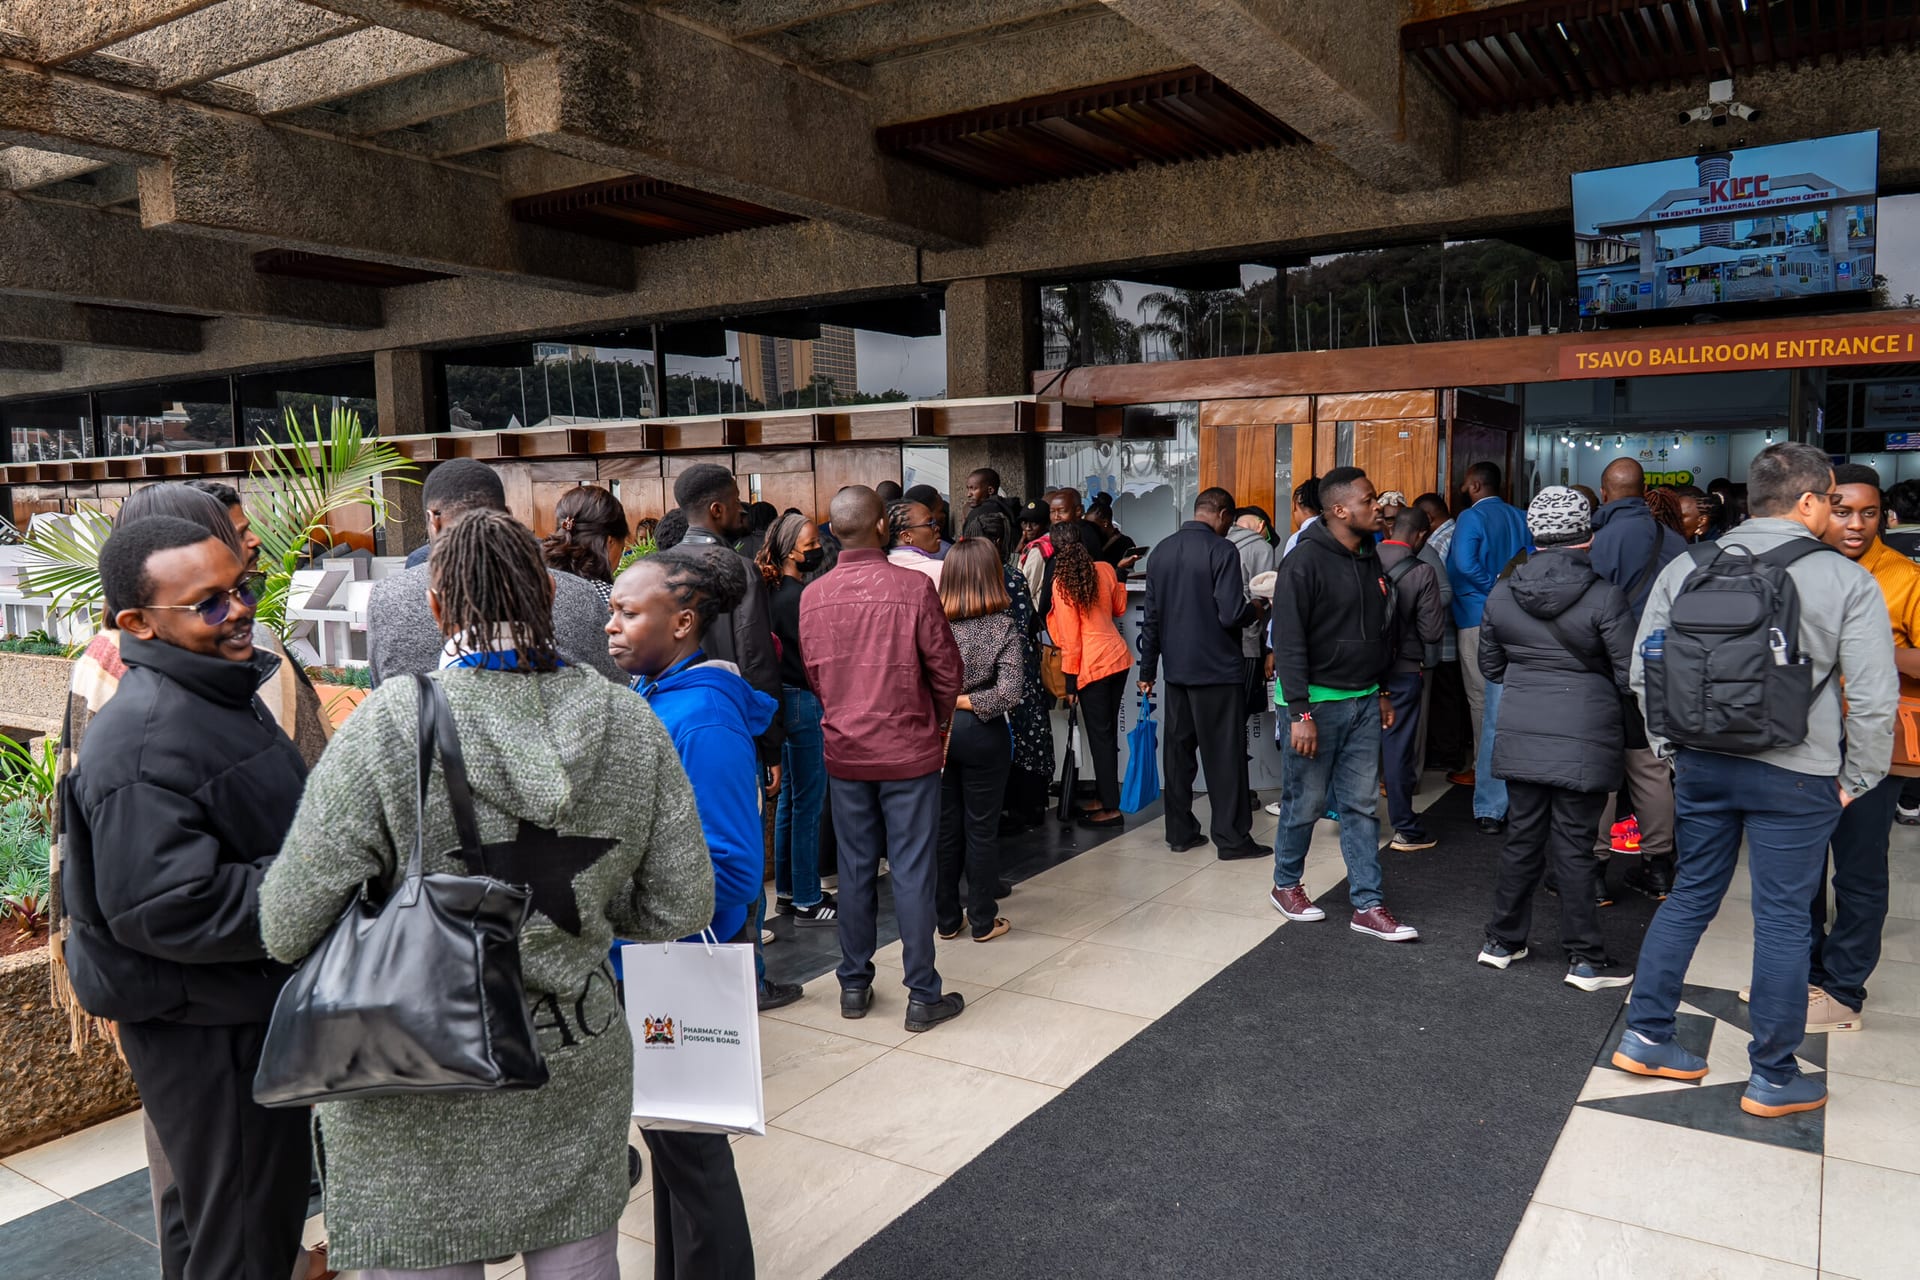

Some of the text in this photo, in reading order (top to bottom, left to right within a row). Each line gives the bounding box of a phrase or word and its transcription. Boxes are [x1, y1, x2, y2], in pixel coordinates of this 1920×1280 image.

[1710, 174, 1769, 203] KICC
[1657, 191, 1829, 219] THE KENYATTA INTERNATIONAL CONVENTION CENTRE
[1576, 349, 1643, 370] TSAVO
[1649, 341, 1769, 366] BALLROOM
[1776, 334, 1900, 359] ENTRANCE
[1643, 471, 1692, 487] ango
[683, 1026, 739, 1037] PHARMACY AND
[684, 1034, 741, 1045] POISONS BOARD
